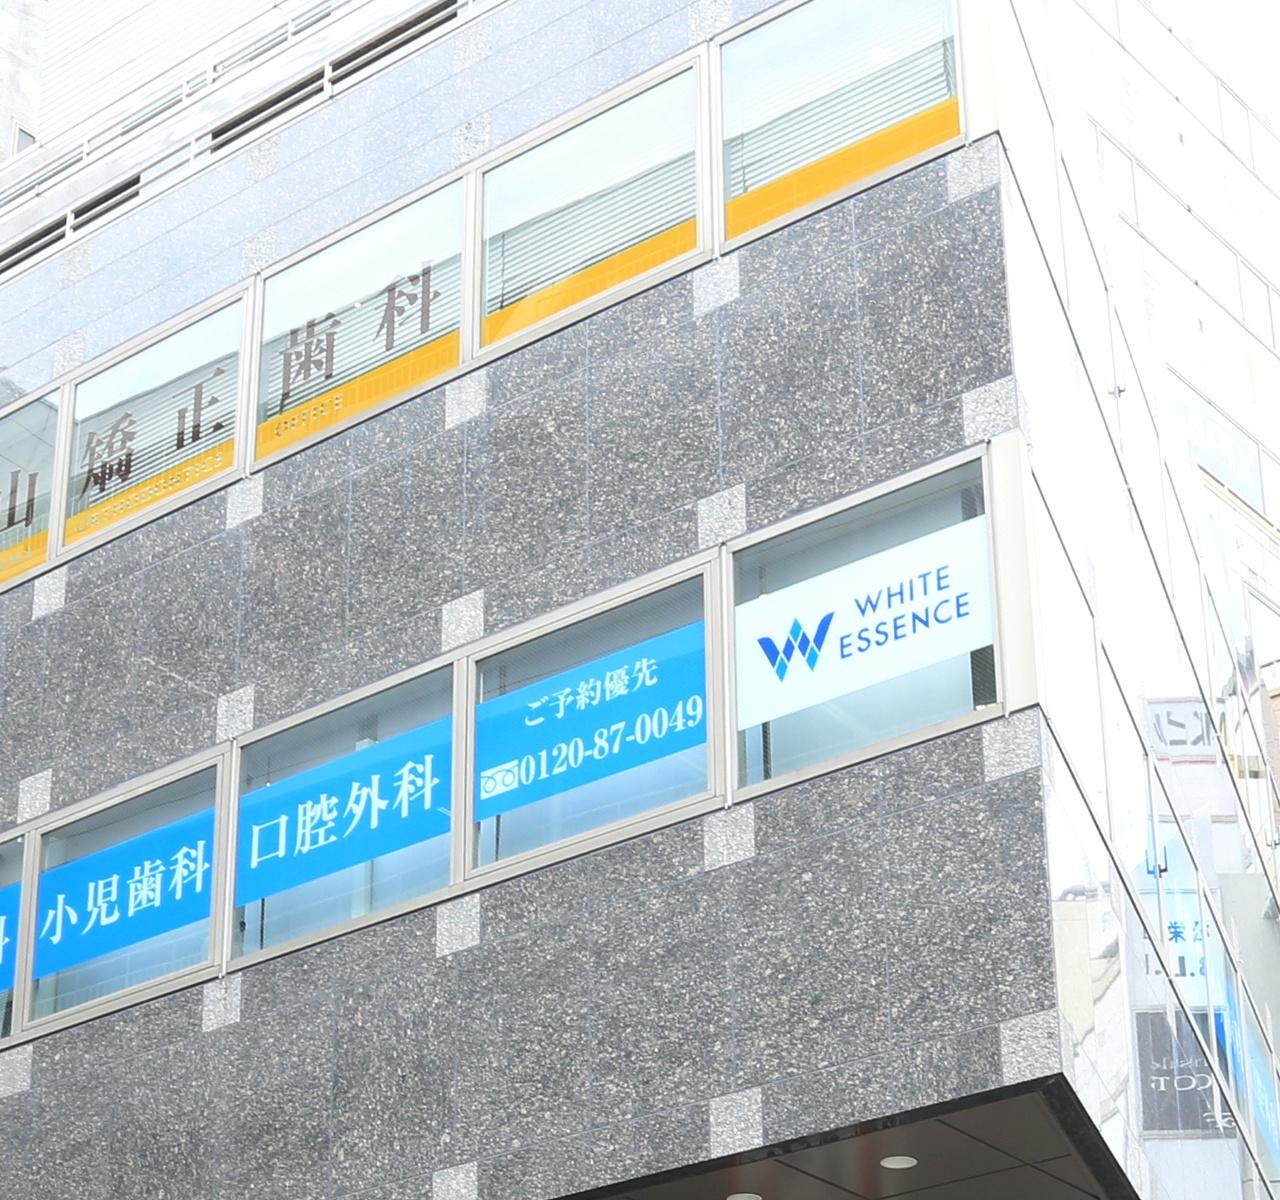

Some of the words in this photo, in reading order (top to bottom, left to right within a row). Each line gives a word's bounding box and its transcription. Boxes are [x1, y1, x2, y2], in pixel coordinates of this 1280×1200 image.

[838, 592, 971, 659] ESSENCE
[853, 565, 951, 618] WHITE
[523, 657, 659, 728] ご予約優先
[519, 695, 705, 787] 0120-87-0049
[249, 754, 440, 869] 口腔外科
[39, 839, 211, 945] 小児歯科
